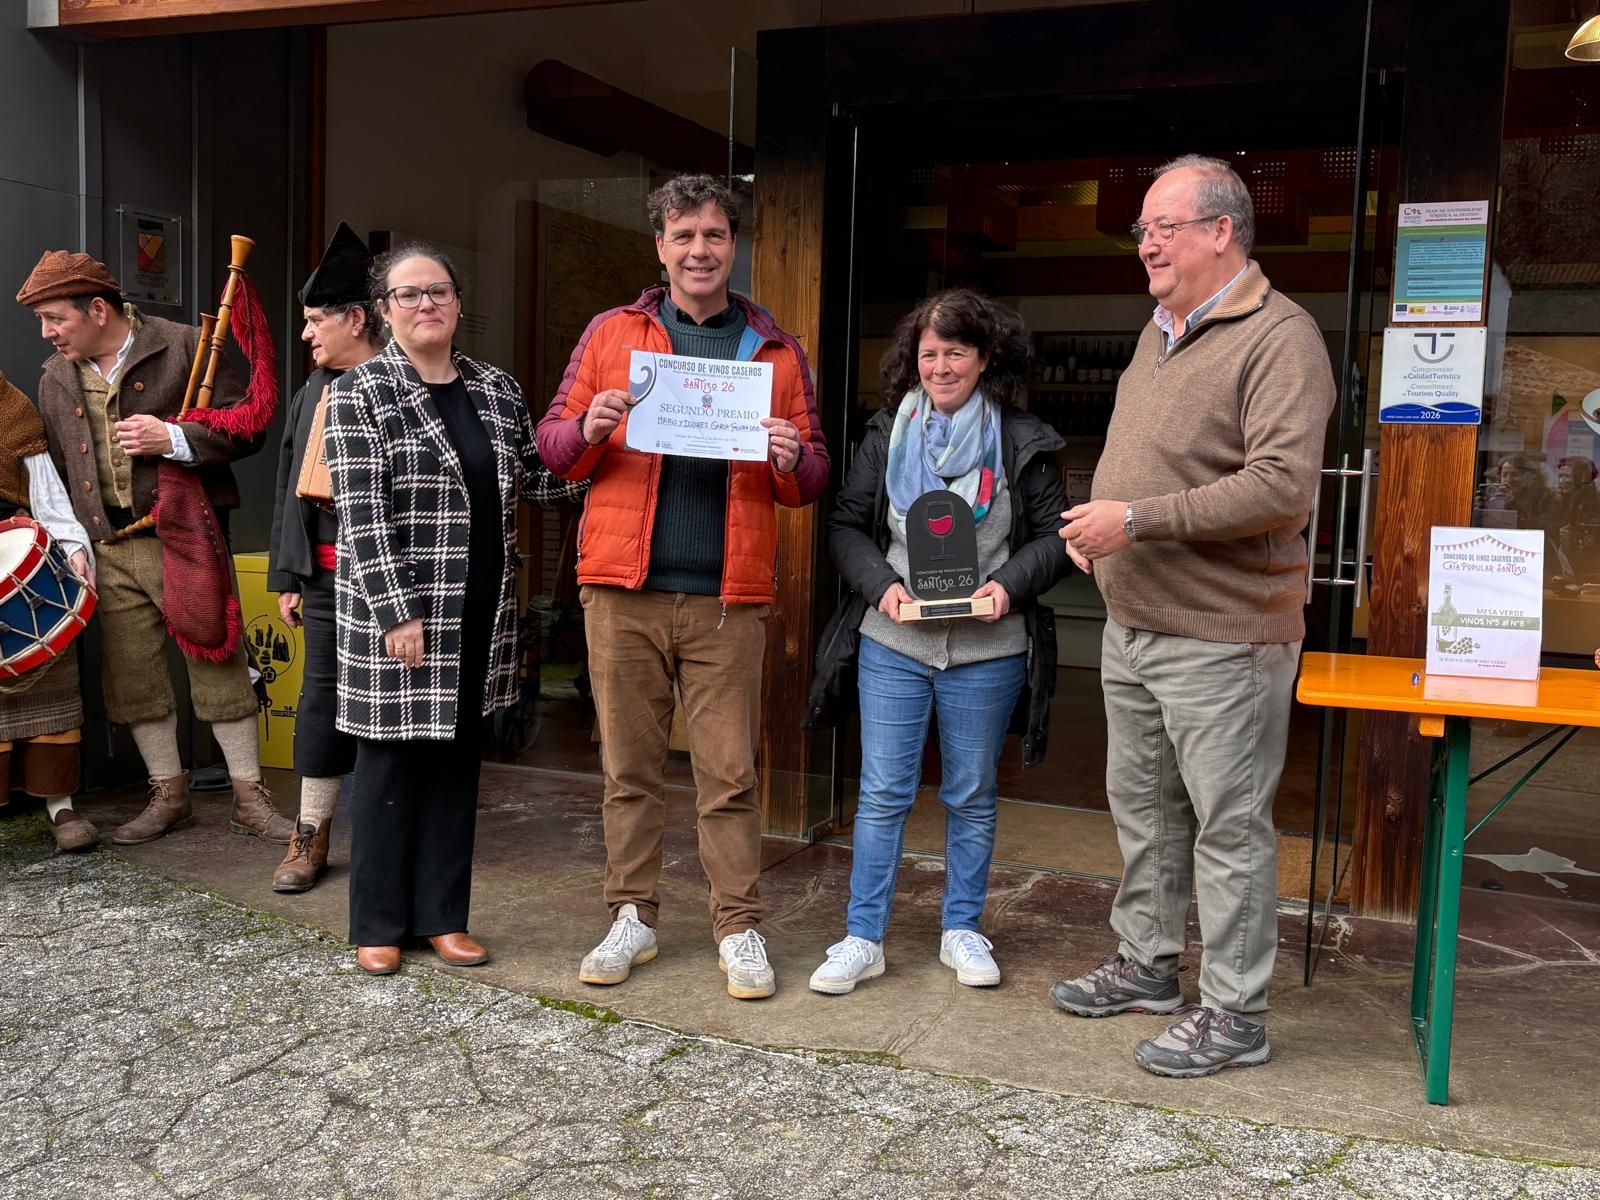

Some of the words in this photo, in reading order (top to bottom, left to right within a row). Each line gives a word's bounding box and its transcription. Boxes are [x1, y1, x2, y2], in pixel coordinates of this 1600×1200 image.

[659, 358, 696, 371] CONCURSO
[697, 363, 707, 373] DE
[708, 364, 730, 375] VINOS
[731, 366, 762, 377] CASEROS
[721, 381, 735, 392] 26
[659, 403, 714, 417] SEGUNDO
[717, 408, 759, 420] PREMIO
[1420, 411, 1441, 419] 2026
[1443, 553, 1467, 561] CONCURSO
[1476, 554, 1490, 562] VINOS
[1491, 555, 1511, 563] CASEROS
[1461, 562, 1494, 573] POPULAR
[958, 574, 974, 587] 26
[1476, 608, 1497, 616] MESA
[1499, 609, 1524, 617] VERDE
[1459, 617, 1485, 625] VINOS
[1501, 618, 1508, 626] al
